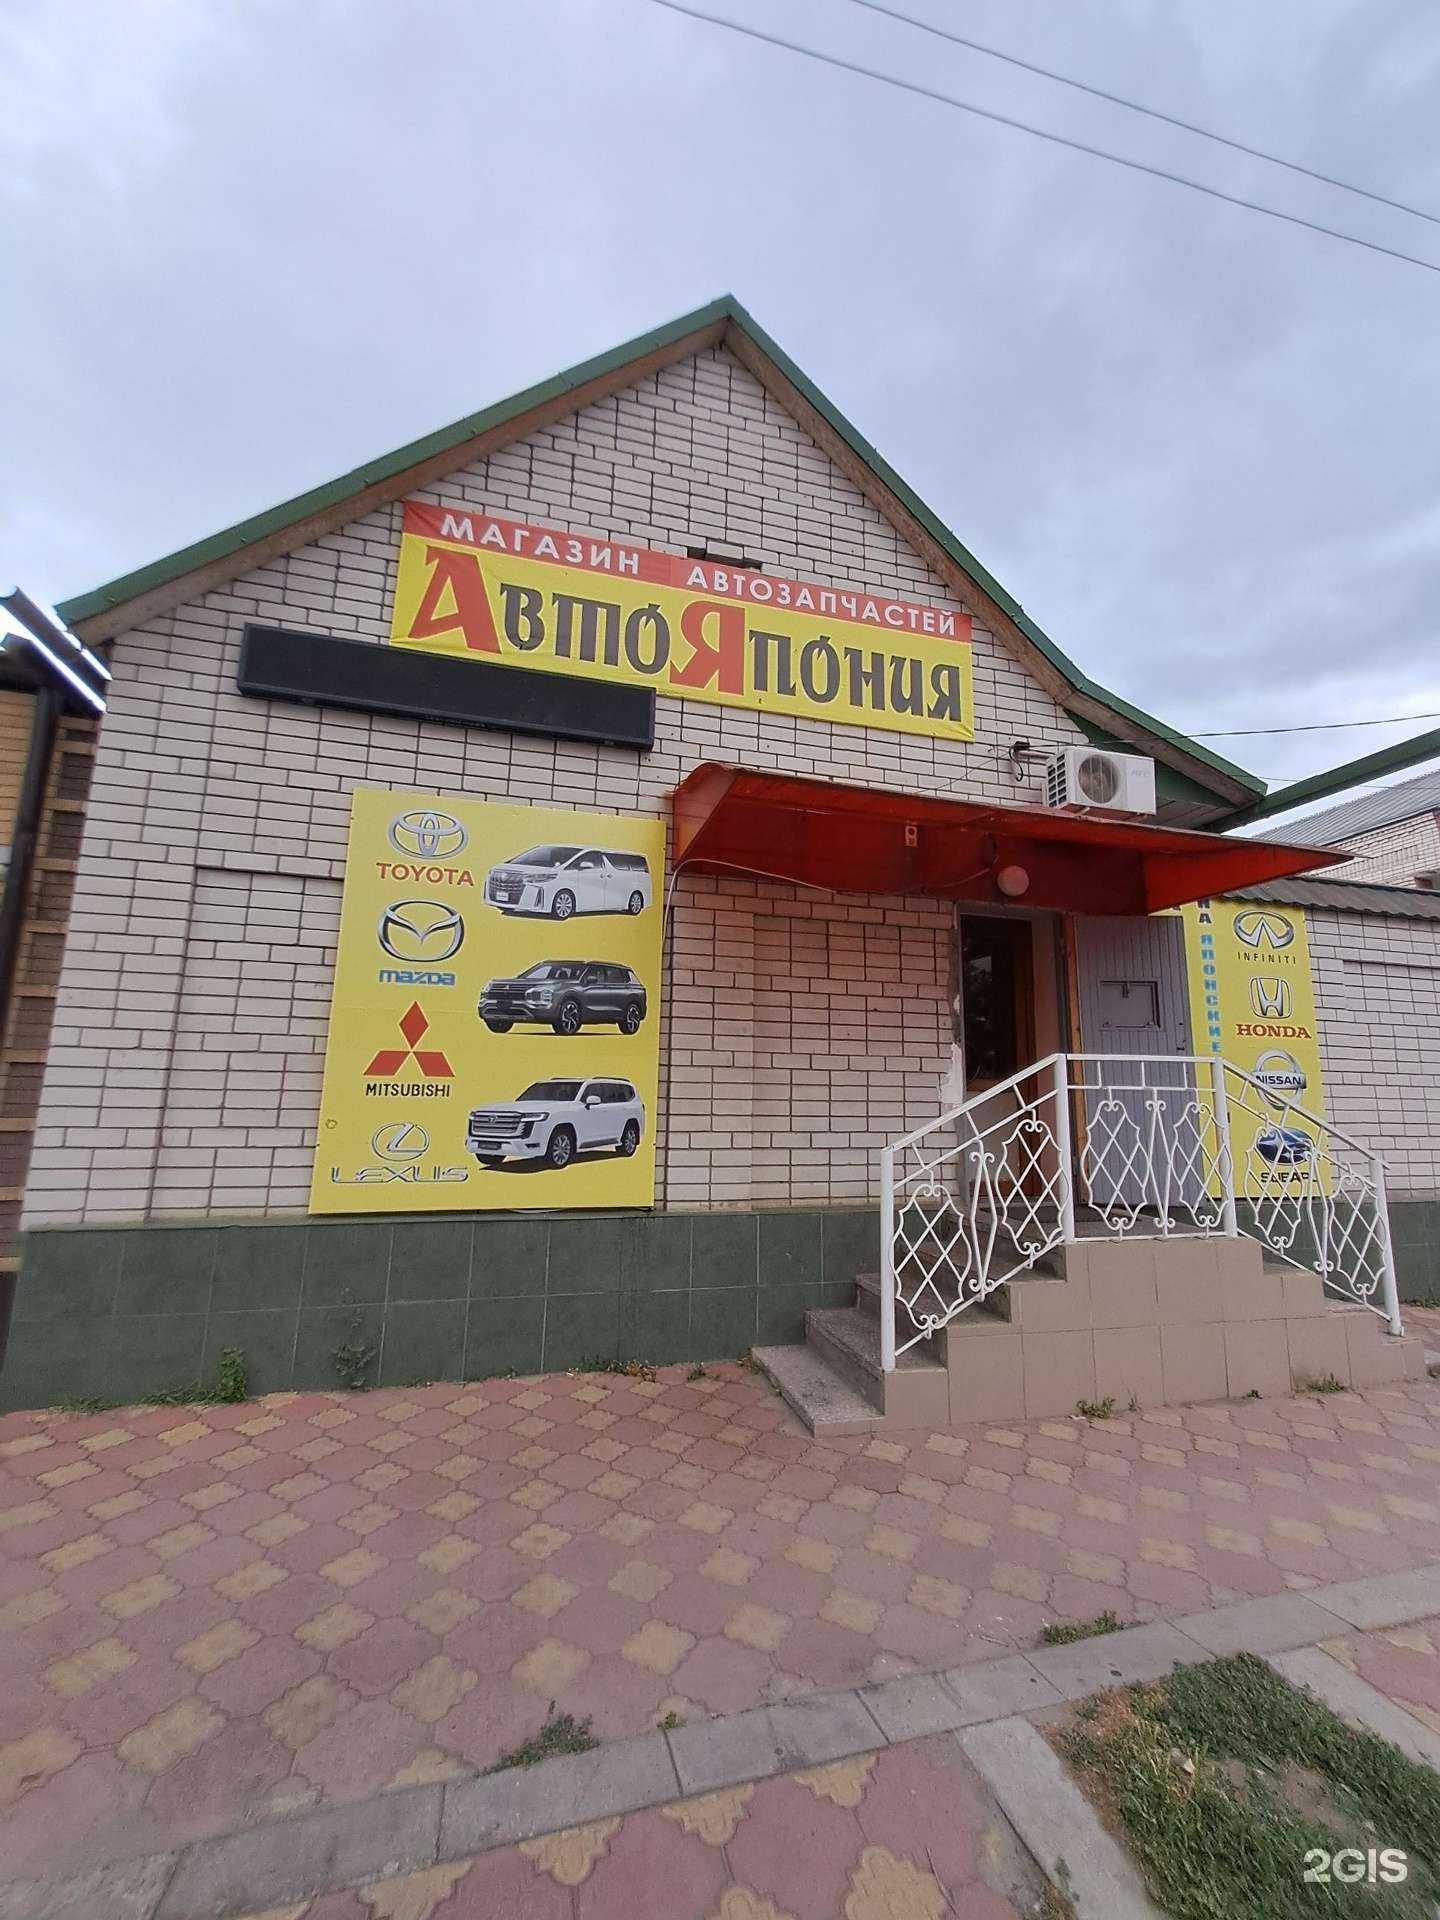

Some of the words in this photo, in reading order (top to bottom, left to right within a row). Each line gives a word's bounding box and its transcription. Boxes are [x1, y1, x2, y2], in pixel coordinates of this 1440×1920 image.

[440, 514, 640, 575] МАГАЗИН
[686, 565, 956, 637] АВТОЗАПЧАСТЕЙ
[376, 862, 474, 887] TOYOTA
[1237, 951, 1297, 965] INFINITI
[1235, 1023, 1312, 1039] HONDA
[1255, 1074, 1302, 1086] NISSAN
[365, 1083, 451, 1098] MITSUBISHI
[331, 1165, 469, 1184] LEXUS
